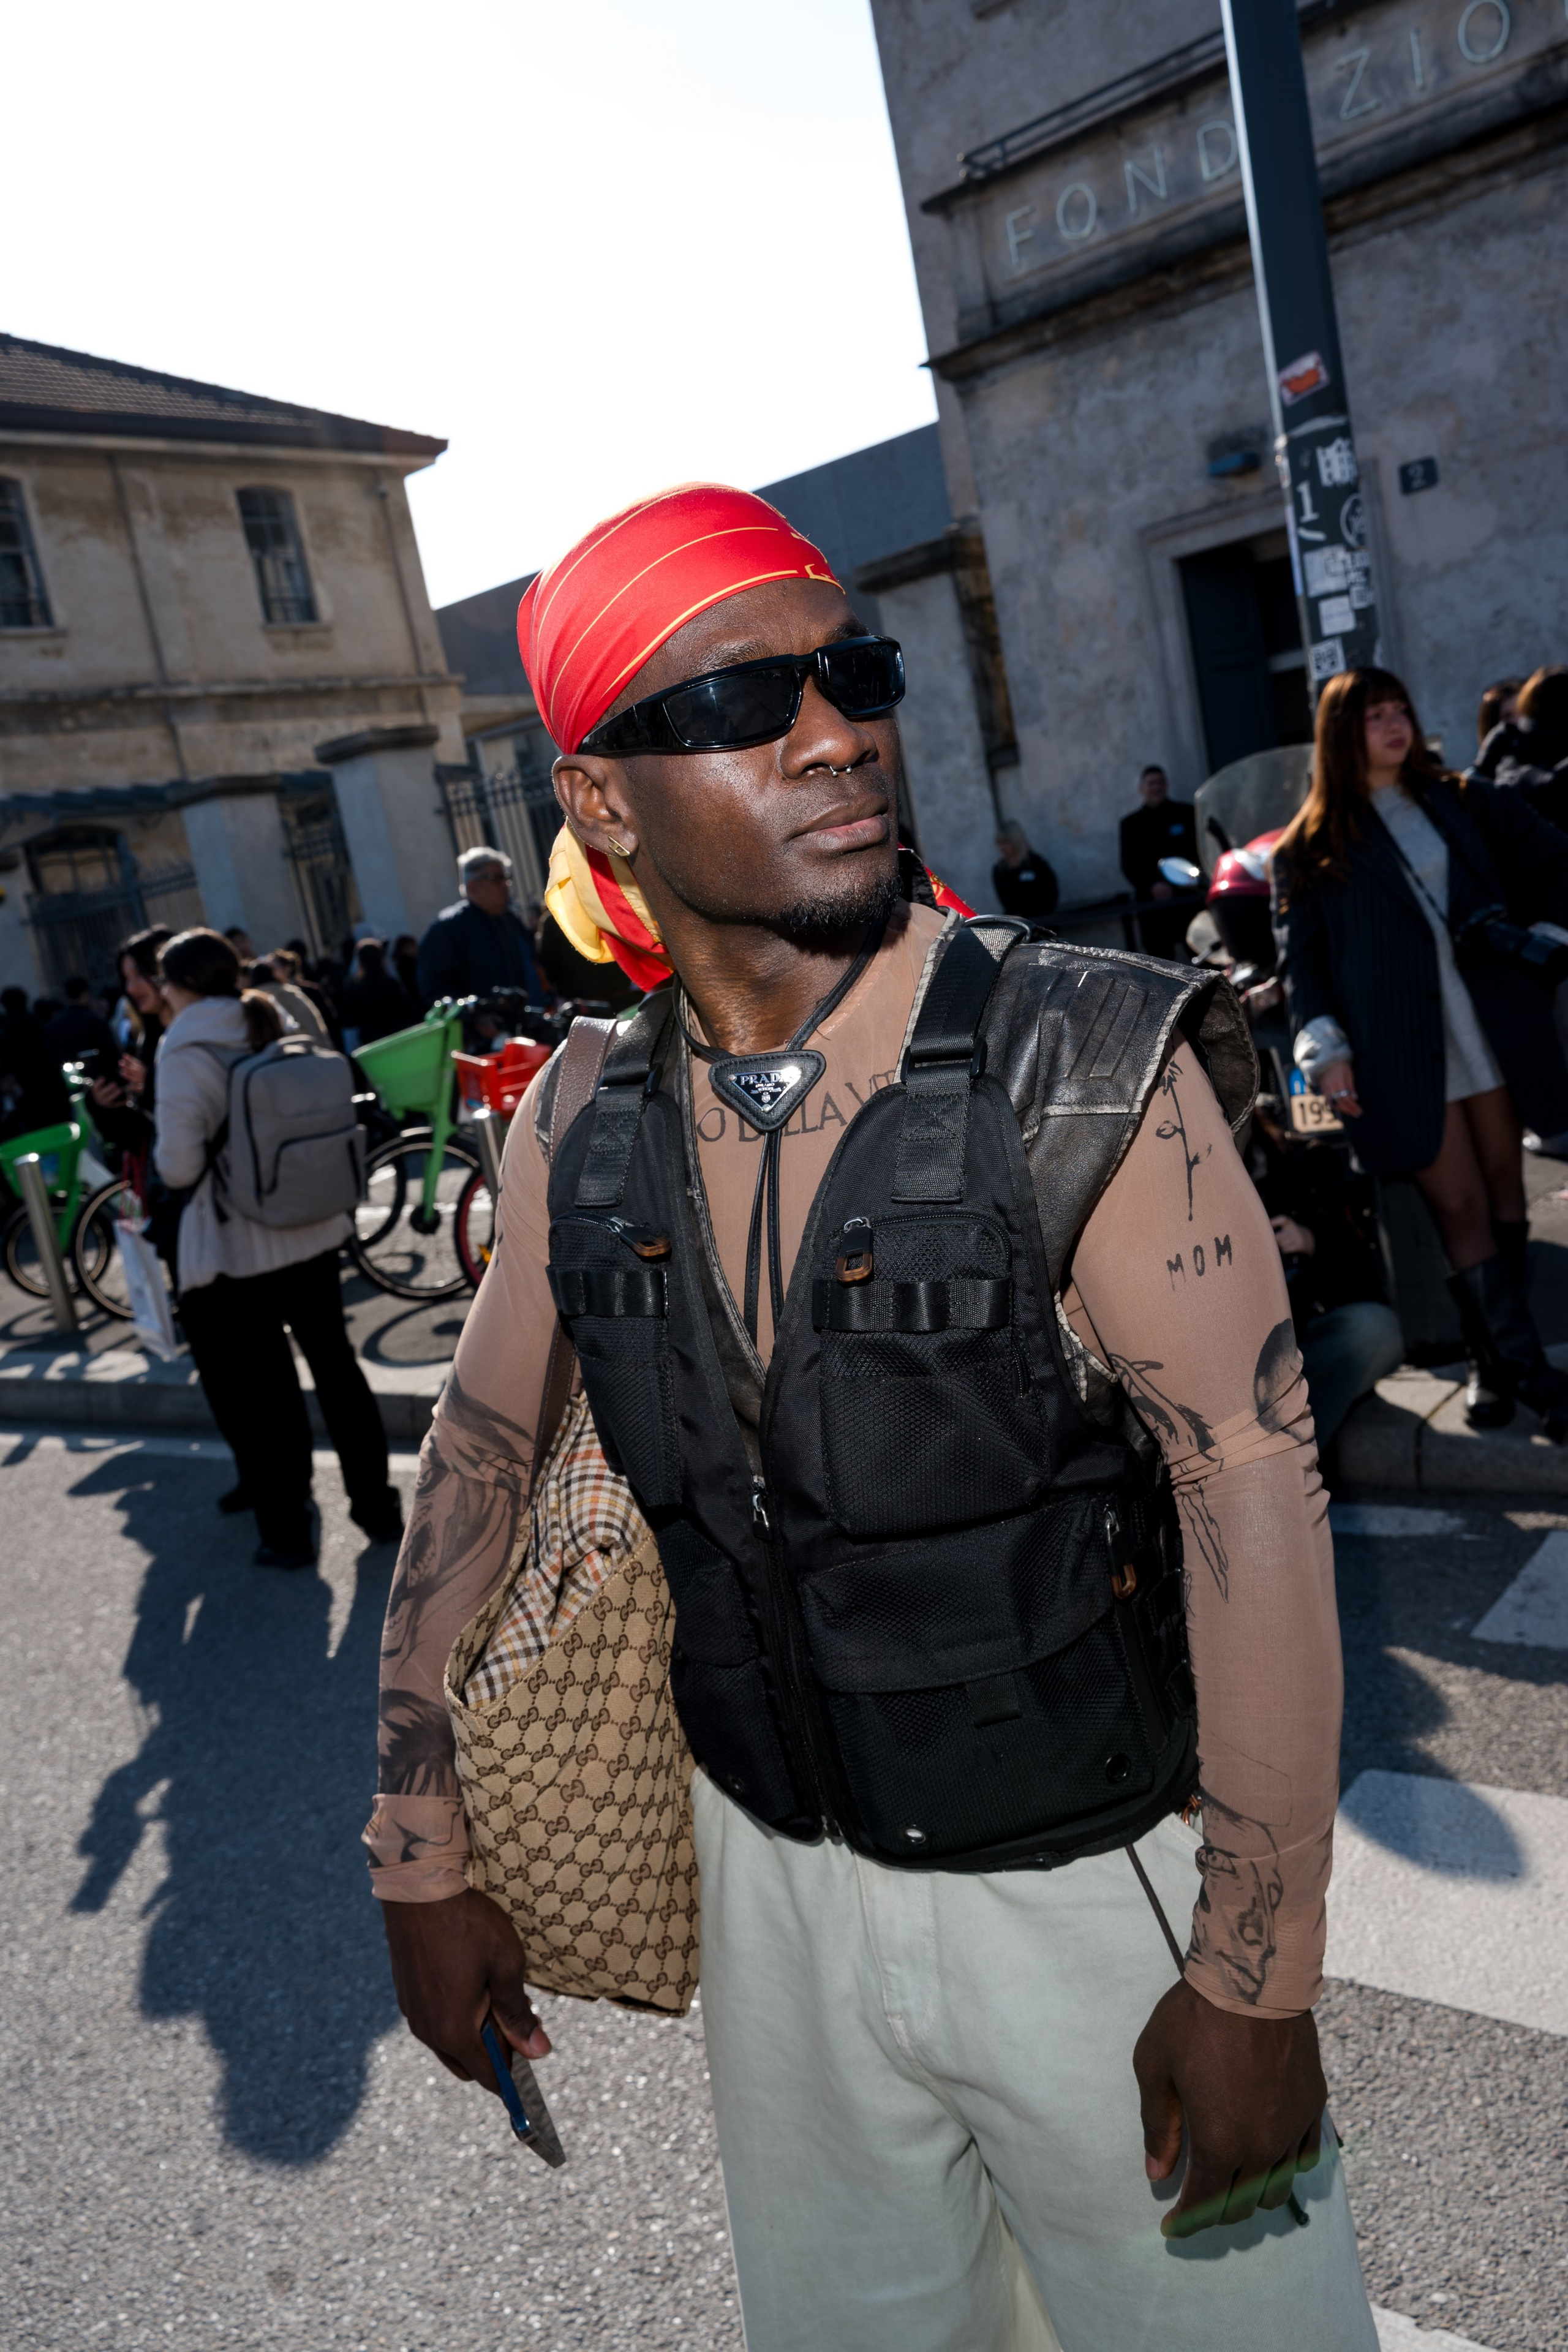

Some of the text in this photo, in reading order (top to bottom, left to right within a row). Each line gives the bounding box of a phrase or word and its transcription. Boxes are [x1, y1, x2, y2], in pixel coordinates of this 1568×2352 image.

[1005, 0, 1568, 267] FONDZIO
[740, 1072, 791, 1085] PRAD
[1166, 1234, 1233, 1291] MOM
